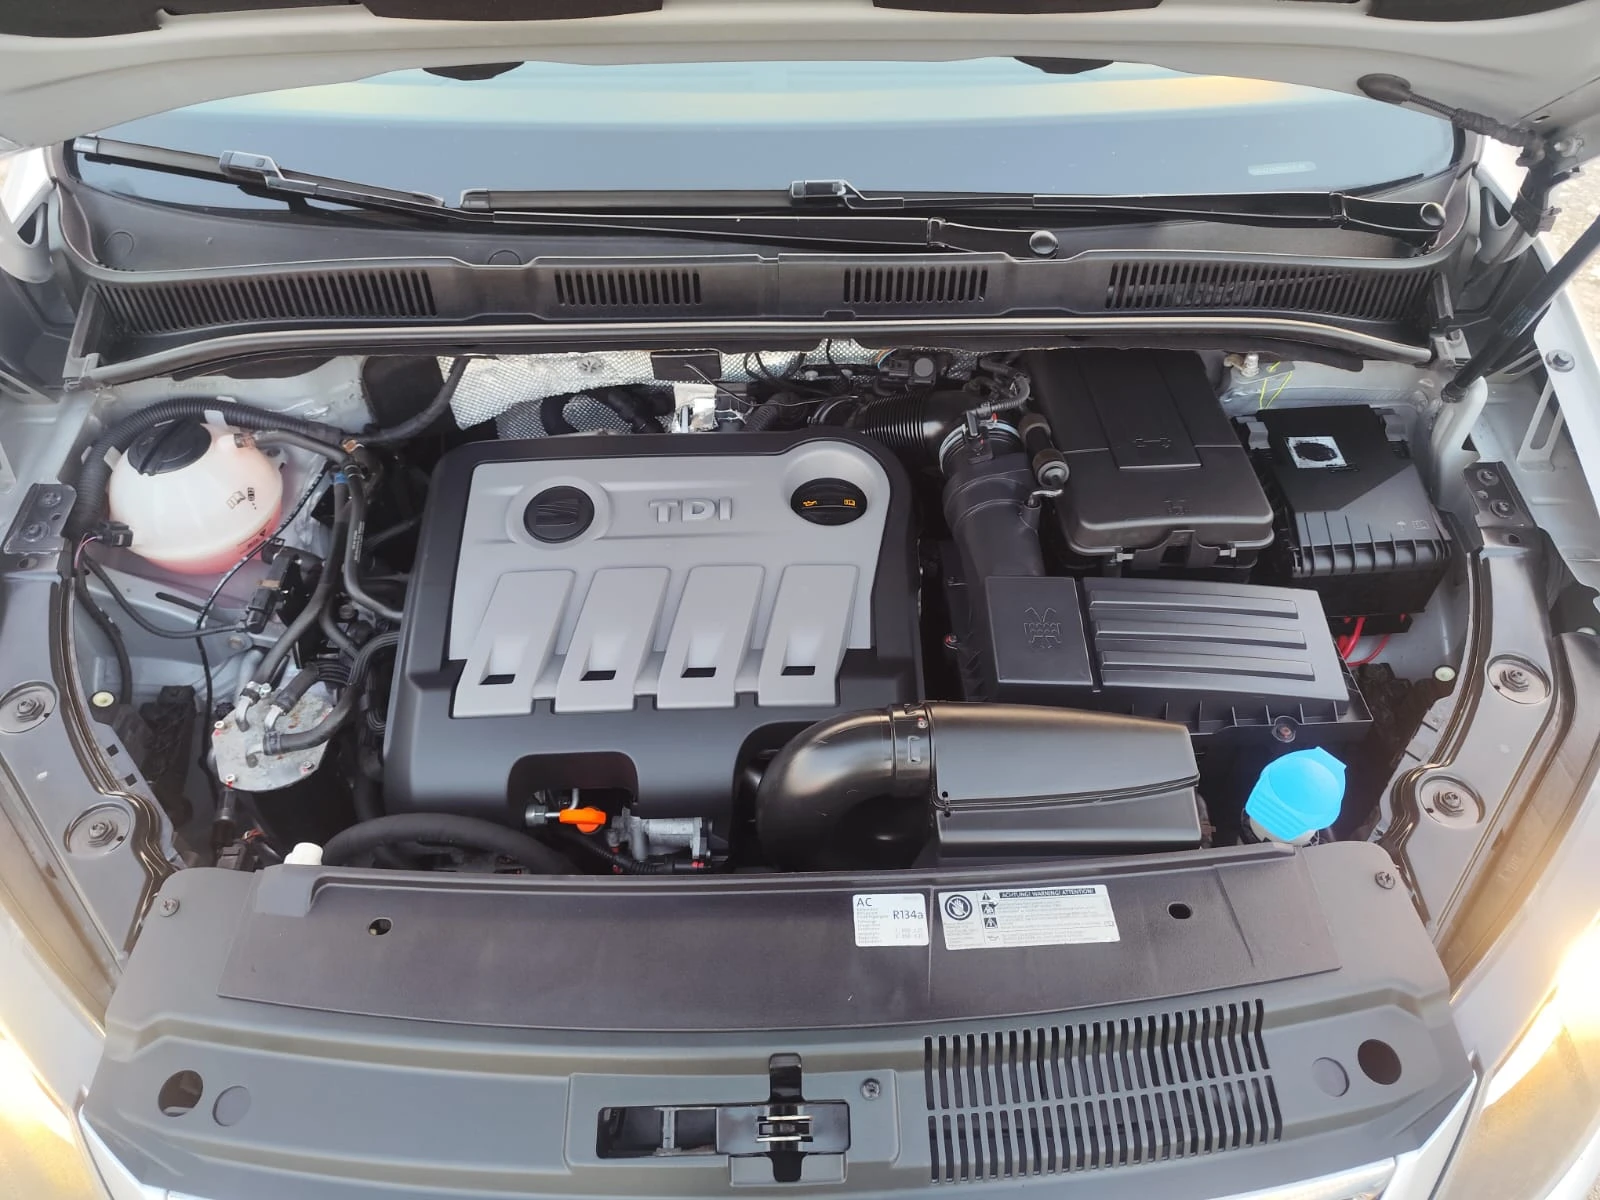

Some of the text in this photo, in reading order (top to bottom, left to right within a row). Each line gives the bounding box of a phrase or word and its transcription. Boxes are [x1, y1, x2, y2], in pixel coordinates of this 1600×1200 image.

[648, 496, 733, 523] TDI
[857, 897, 873, 908] AC
[893, 910, 924, 920] R134a
